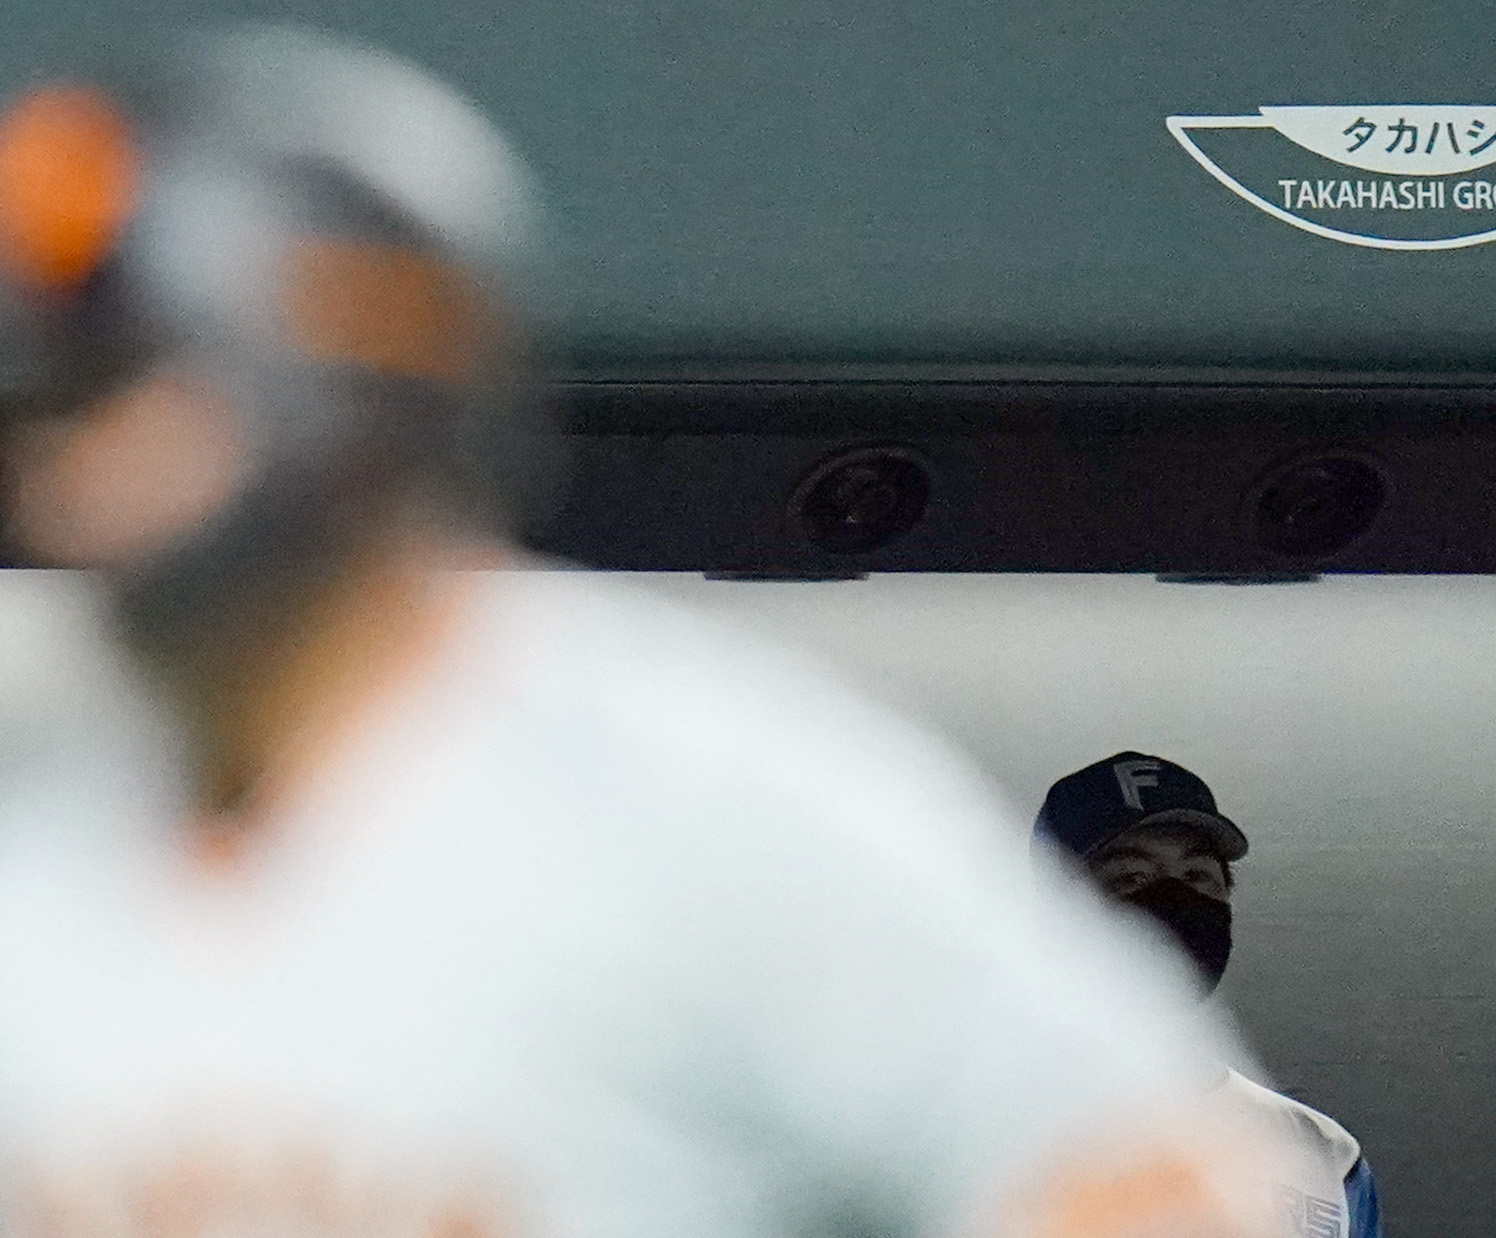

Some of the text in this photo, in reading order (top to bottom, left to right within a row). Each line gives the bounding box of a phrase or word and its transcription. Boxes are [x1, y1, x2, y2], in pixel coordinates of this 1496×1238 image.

[1277, 179, 1496, 210] TAKAHASHI GR
[1113, 760, 1163, 812] F
